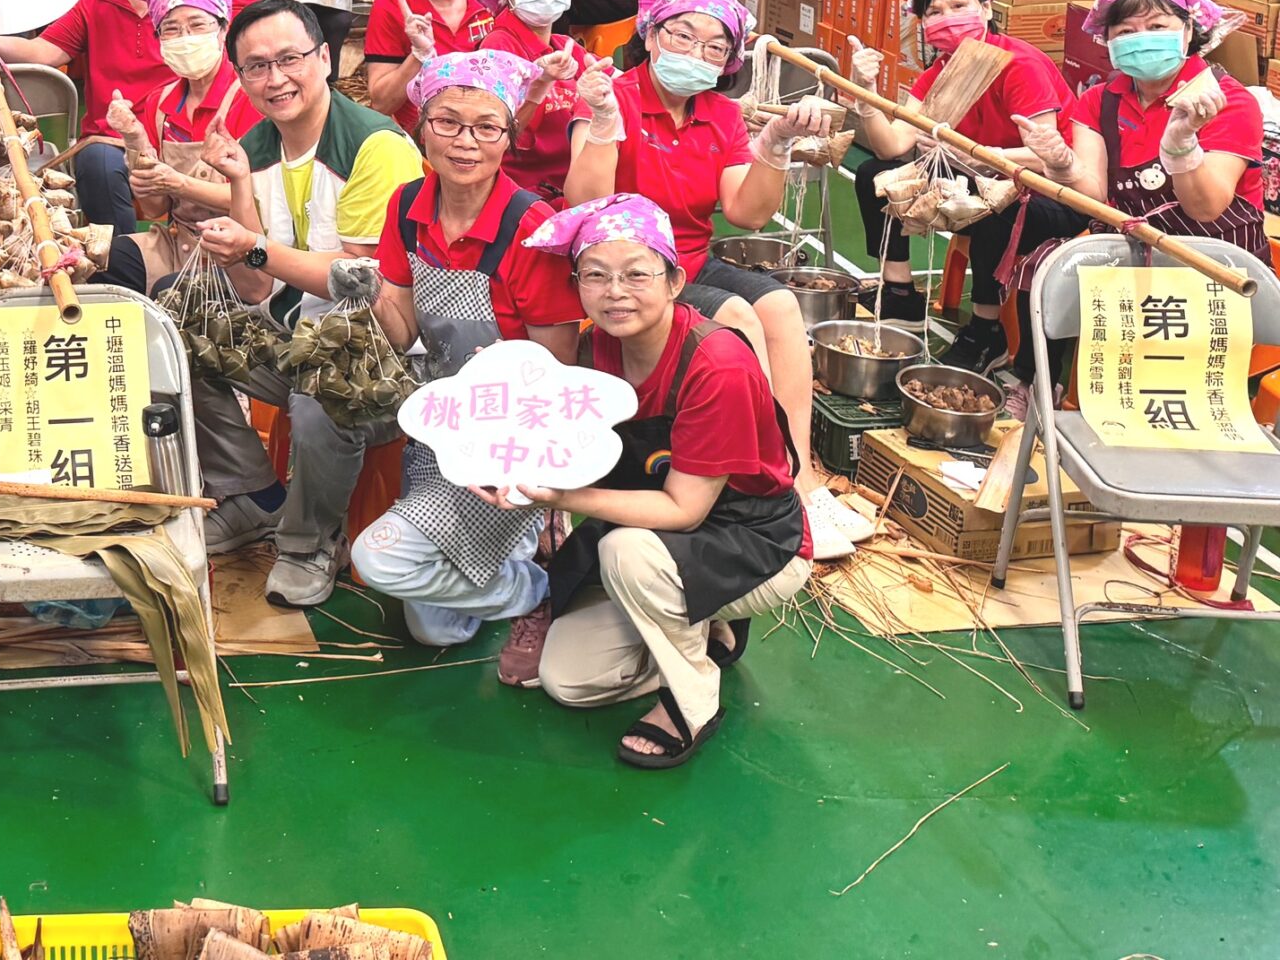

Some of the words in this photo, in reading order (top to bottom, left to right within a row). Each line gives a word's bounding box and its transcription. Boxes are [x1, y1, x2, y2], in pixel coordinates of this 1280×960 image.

[420, 382, 604, 431] 桃園家扶
[1139, 294, 1200, 431] 第二組
[43, 334, 95, 489] 第一組
[489, 436, 572, 475] 中心
